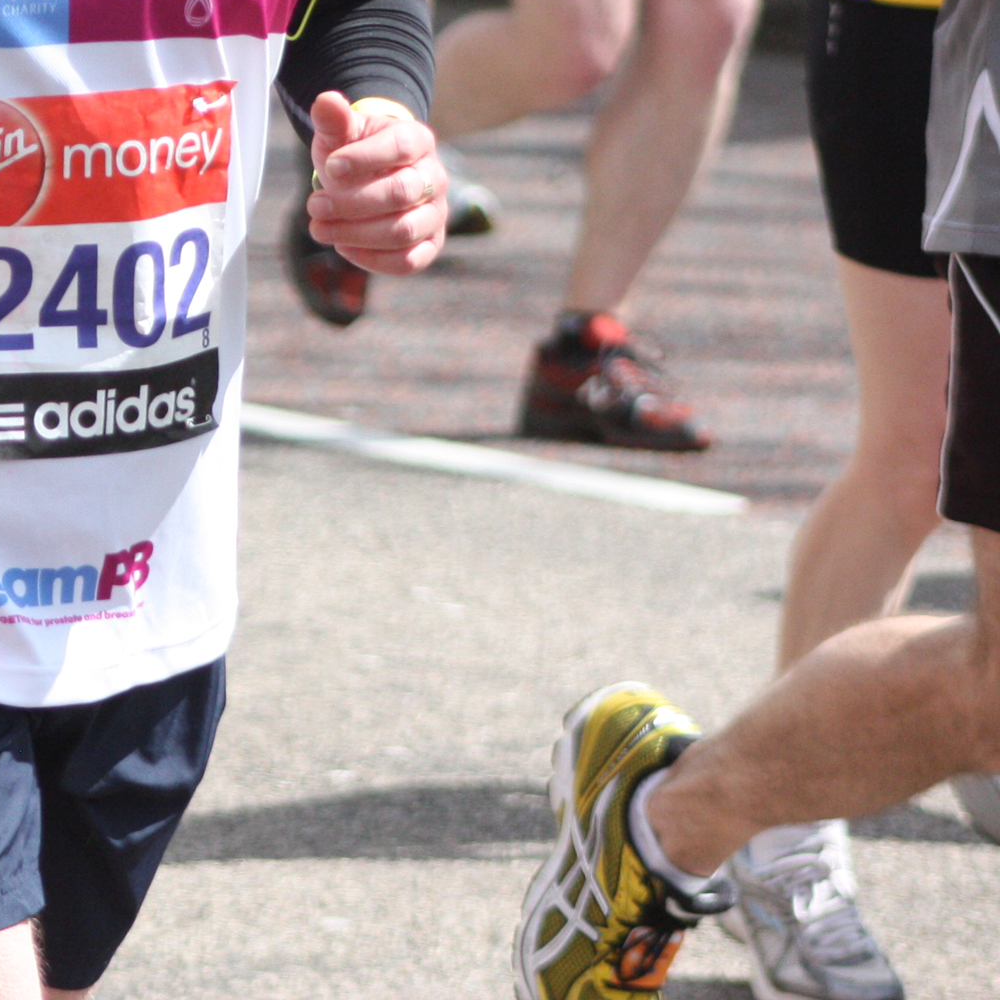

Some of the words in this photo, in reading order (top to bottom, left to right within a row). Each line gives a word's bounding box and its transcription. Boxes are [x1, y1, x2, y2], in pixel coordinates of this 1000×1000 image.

[2, 2, 57, 17] CHARITY
[63, 127, 223, 180] money
[202, 327, 210, 348] 8
[34, 385, 196, 440] adidas
[45, 615, 83, 627] prostate
[84, 611, 102, 621] and
